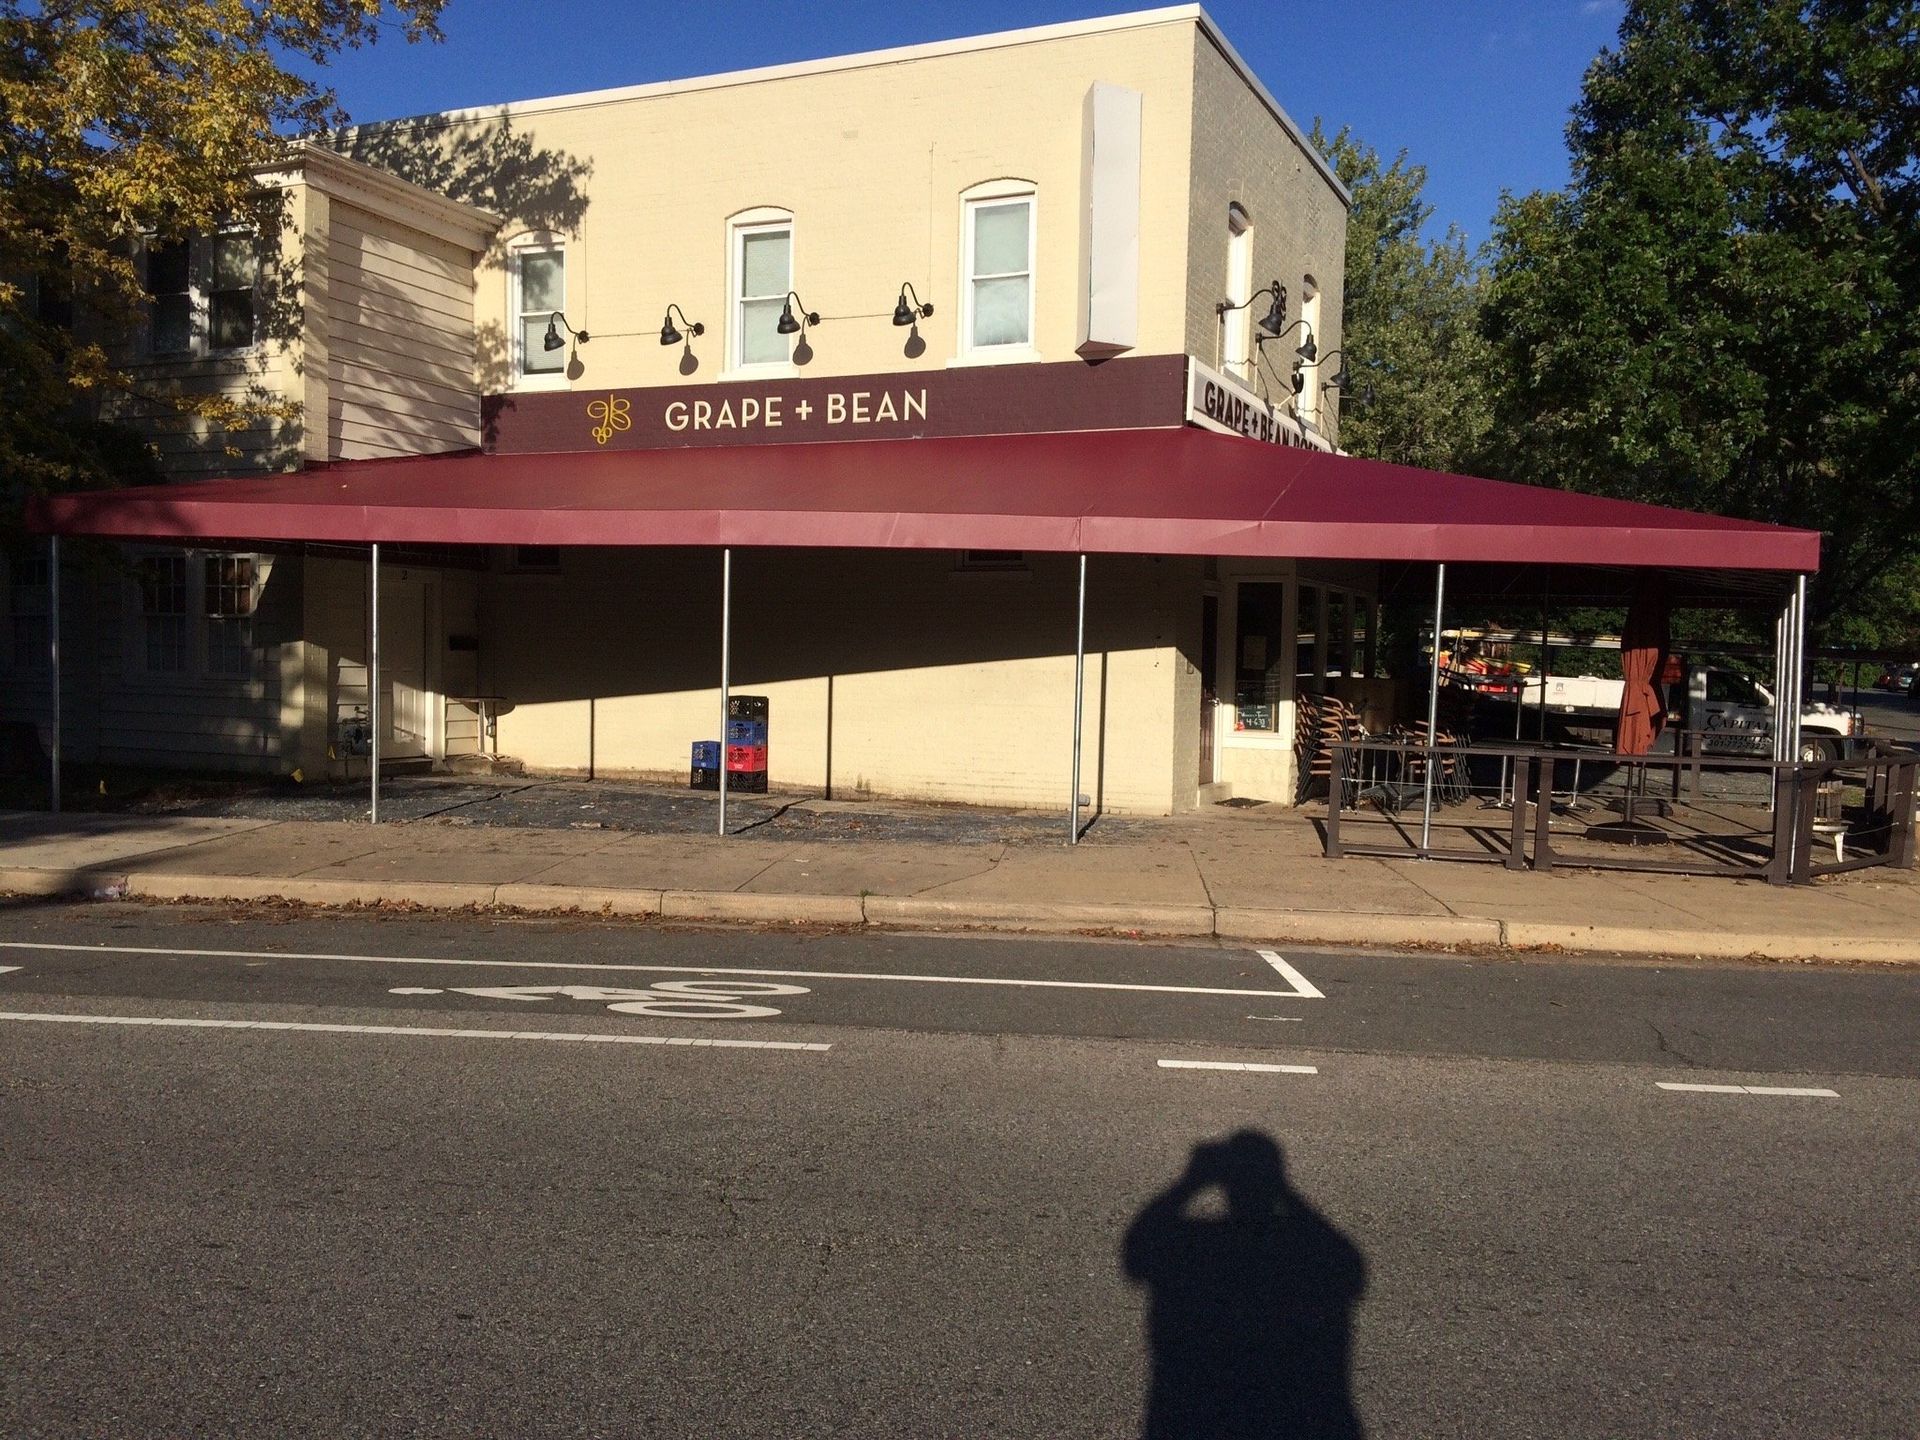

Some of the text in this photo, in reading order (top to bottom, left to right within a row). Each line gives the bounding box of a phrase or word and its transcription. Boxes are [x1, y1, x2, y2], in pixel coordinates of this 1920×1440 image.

[664, 389, 927, 431] GRAPE + BEAN
[1204, 380, 1250, 434] GRAPE
[1260, 412, 1290, 446] BEAN
